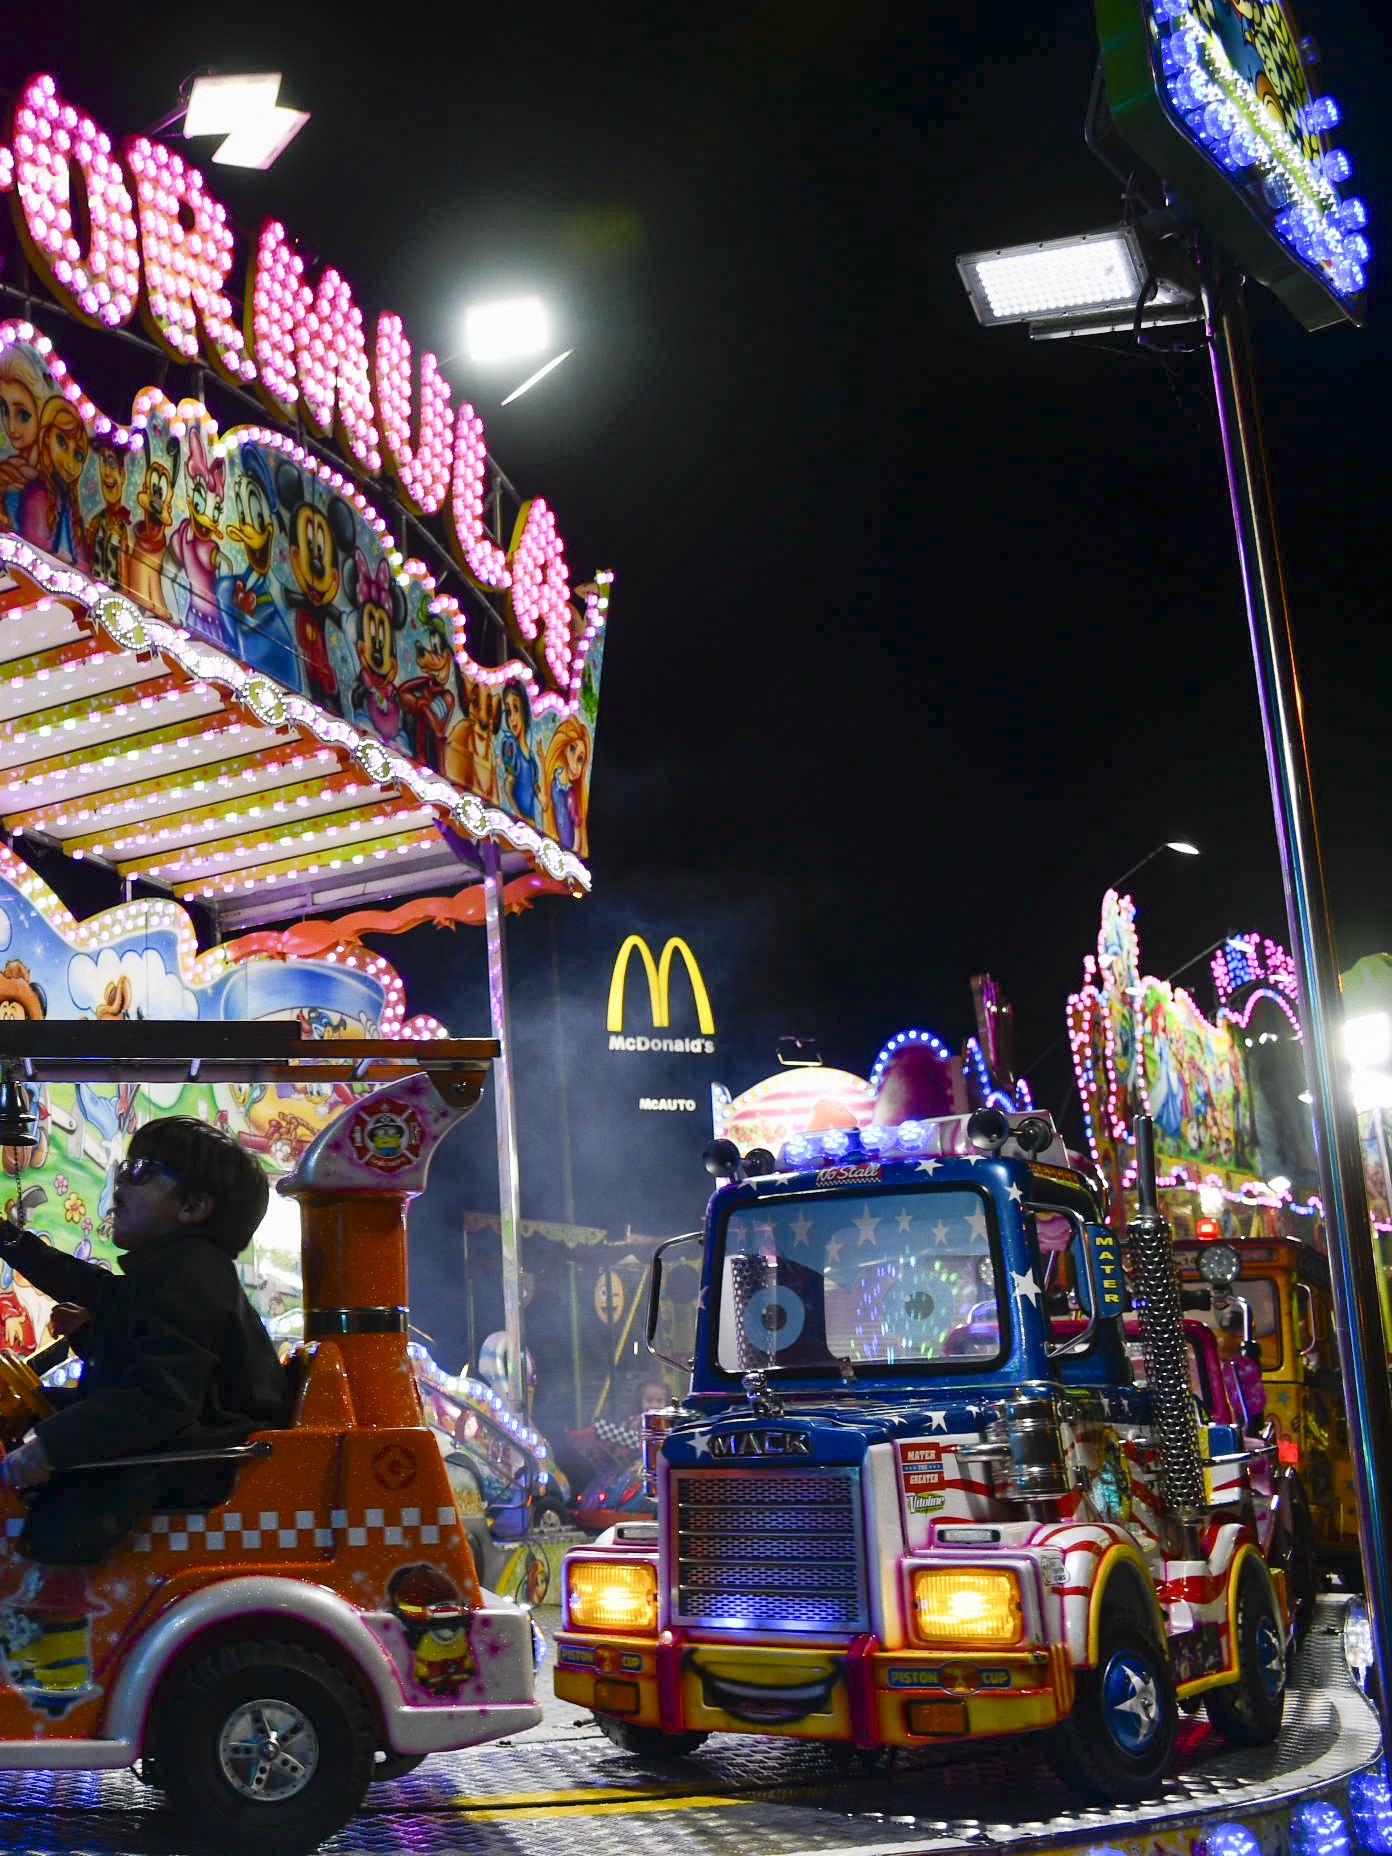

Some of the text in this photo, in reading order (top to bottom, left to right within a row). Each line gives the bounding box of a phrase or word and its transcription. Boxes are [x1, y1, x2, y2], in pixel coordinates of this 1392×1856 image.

[608, 1035, 715, 1054] McDonald's
[639, 1098, 697, 1112] McAUTO
[838, 1163, 881, 1180] Stall
[1095, 1236, 1120, 1303] MATER
[710, 1431, 810, 1458] MACK
[906, 1449, 937, 1461] MATER
[890, 1671, 1009, 1684] PISTON CUP
